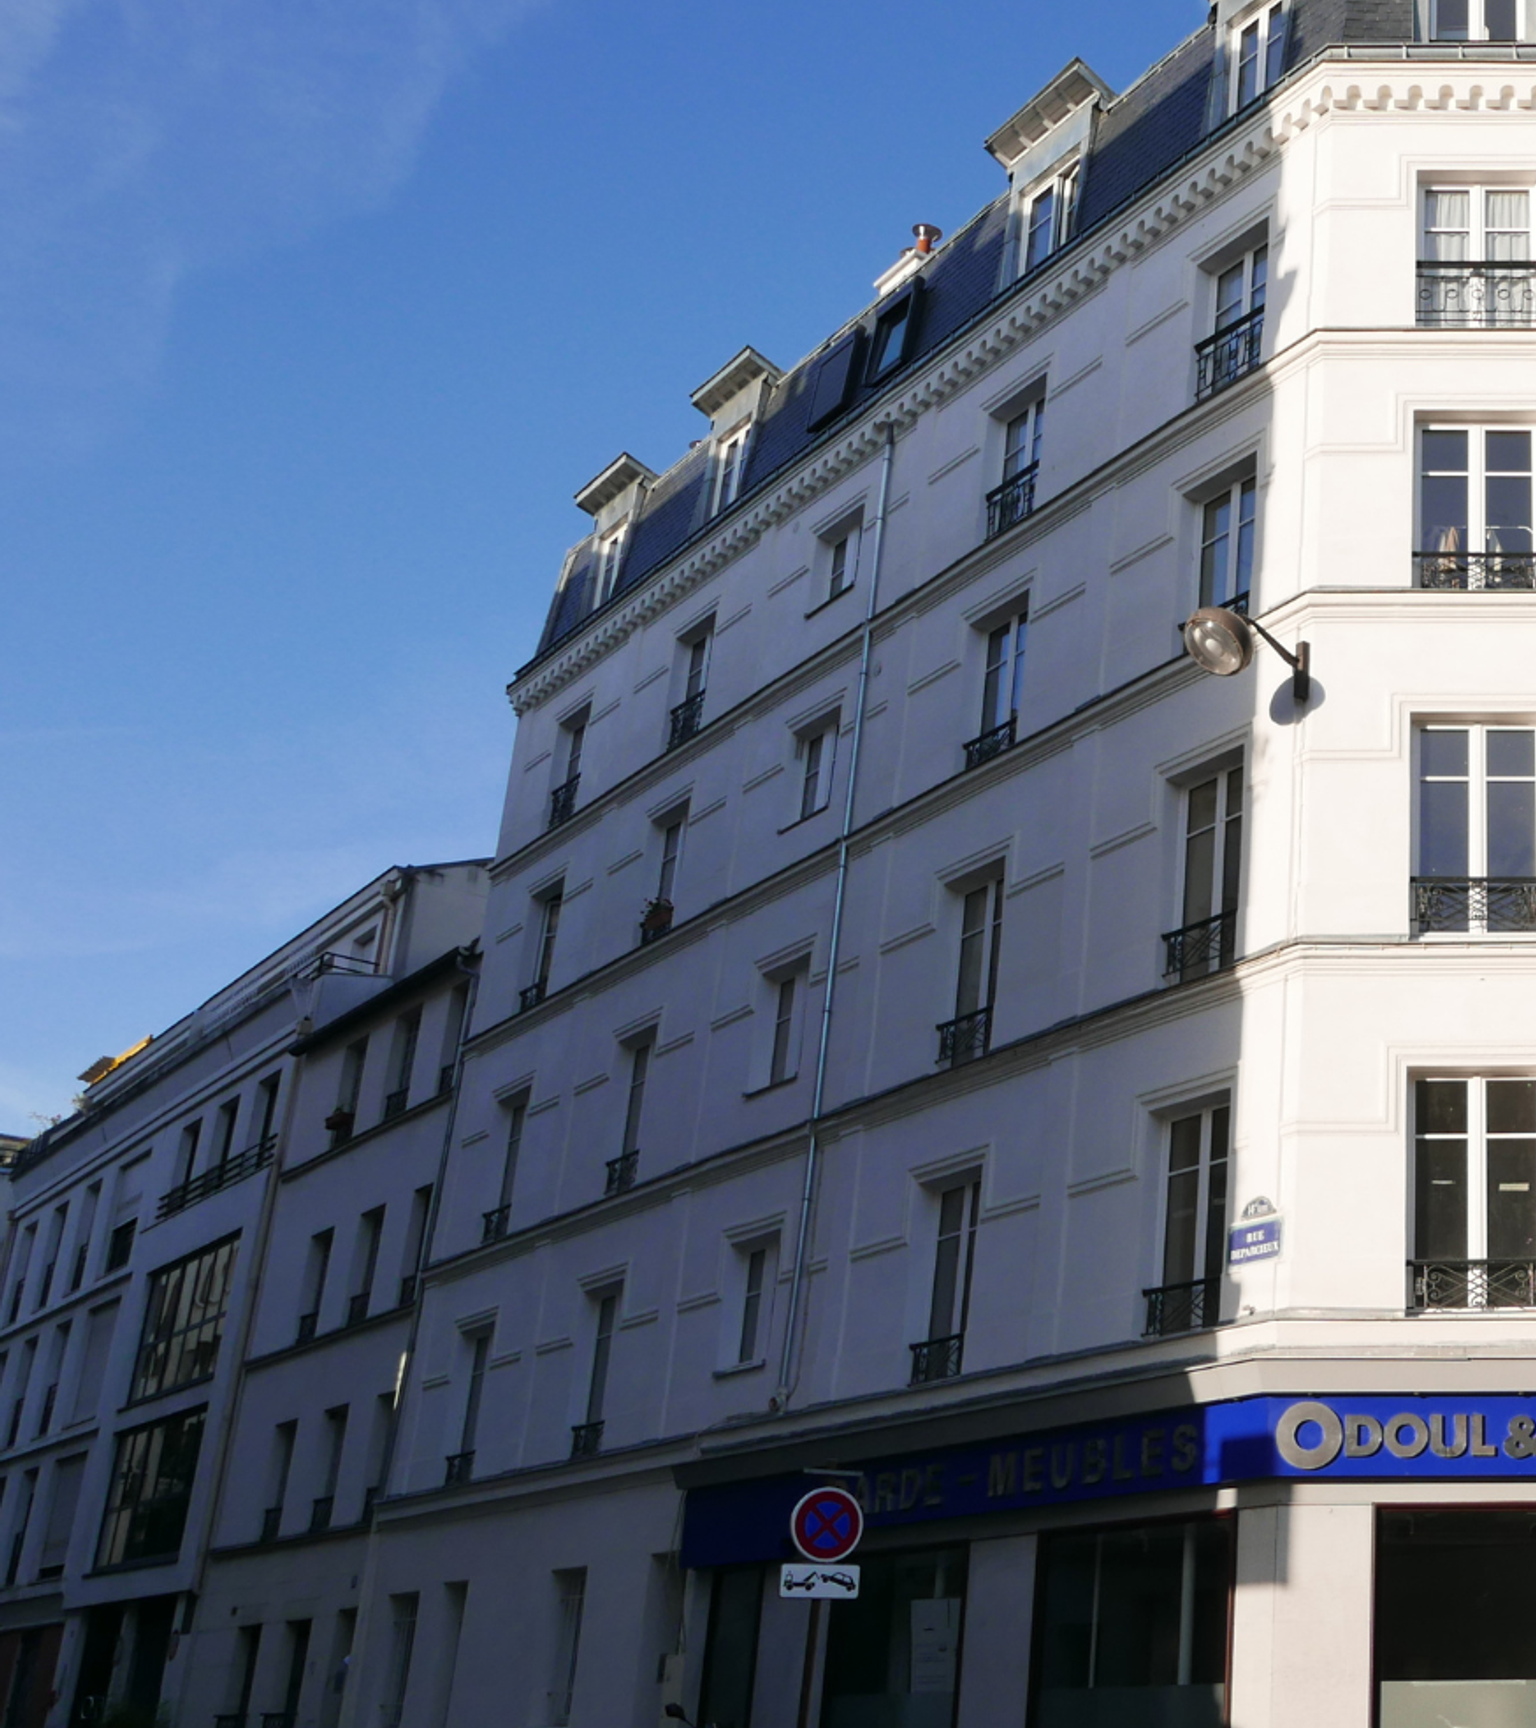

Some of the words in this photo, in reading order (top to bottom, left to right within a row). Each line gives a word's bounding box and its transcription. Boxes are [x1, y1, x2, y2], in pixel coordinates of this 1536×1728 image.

[1246, 1229, 1265, 1243] RUE
[828, 1463, 945, 1514] ARDE
[988, 1424, 1198, 1498] MEUBLES
[1276, 1401, 1496, 1470] ODOUL
